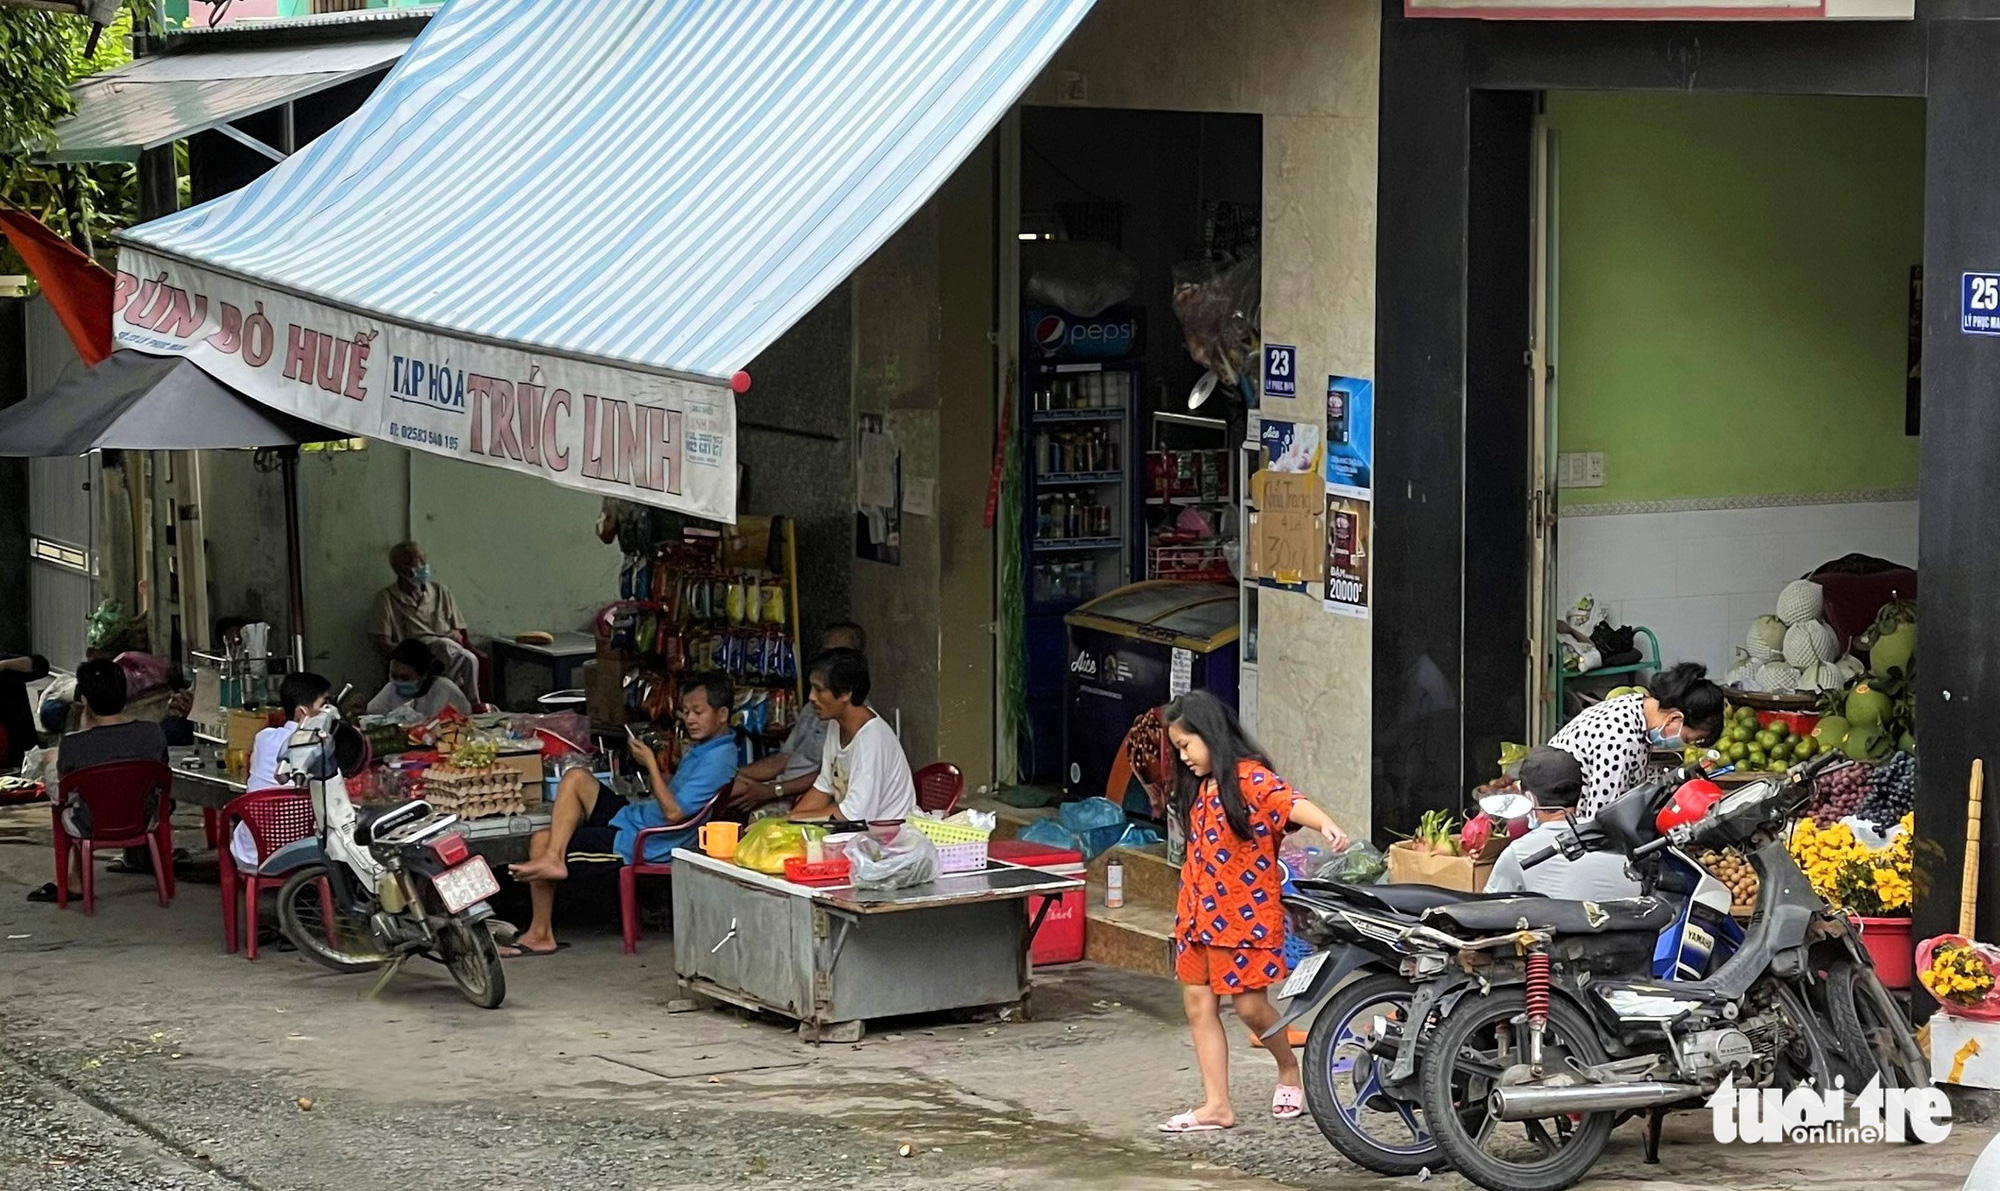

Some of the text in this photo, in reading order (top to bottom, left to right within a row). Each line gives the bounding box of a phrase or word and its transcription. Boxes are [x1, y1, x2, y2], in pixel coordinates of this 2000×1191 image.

[1971, 277, 1998, 310] 25
[112, 271, 379, 401] BÚN BÒ HUẾ
[1071, 319, 1135, 345] pepsi
[1270, 349, 1290, 377] 23
[429, 358, 465, 407] HÓA
[467, 365, 682, 496] TRÚC LINH
[1070, 650, 1097, 674] Aice
